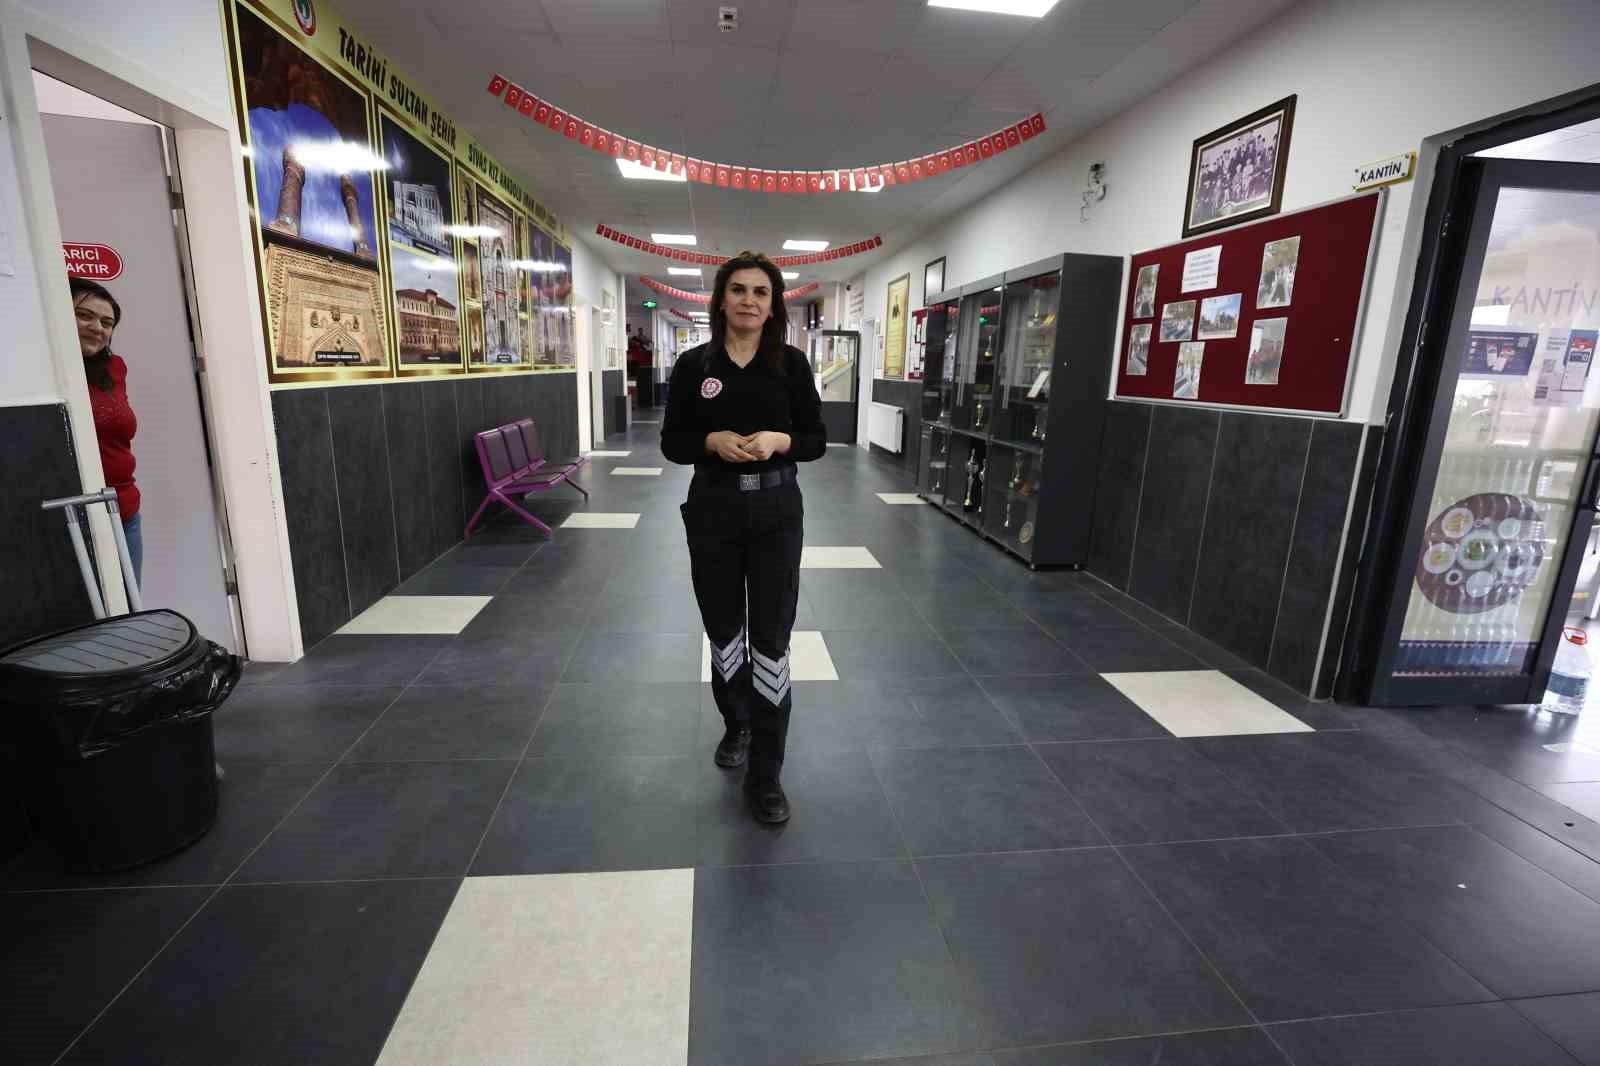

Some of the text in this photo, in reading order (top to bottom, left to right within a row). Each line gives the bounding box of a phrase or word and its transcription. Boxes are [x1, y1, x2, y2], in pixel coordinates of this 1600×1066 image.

[338, 26, 457, 151] TARİHİ SULTAN ŞEHİR
[1360, 161, 1402, 183] KANTİN
[63, 247, 100, 260] ARİCİ
[65, 262, 110, 274] AKTIR
